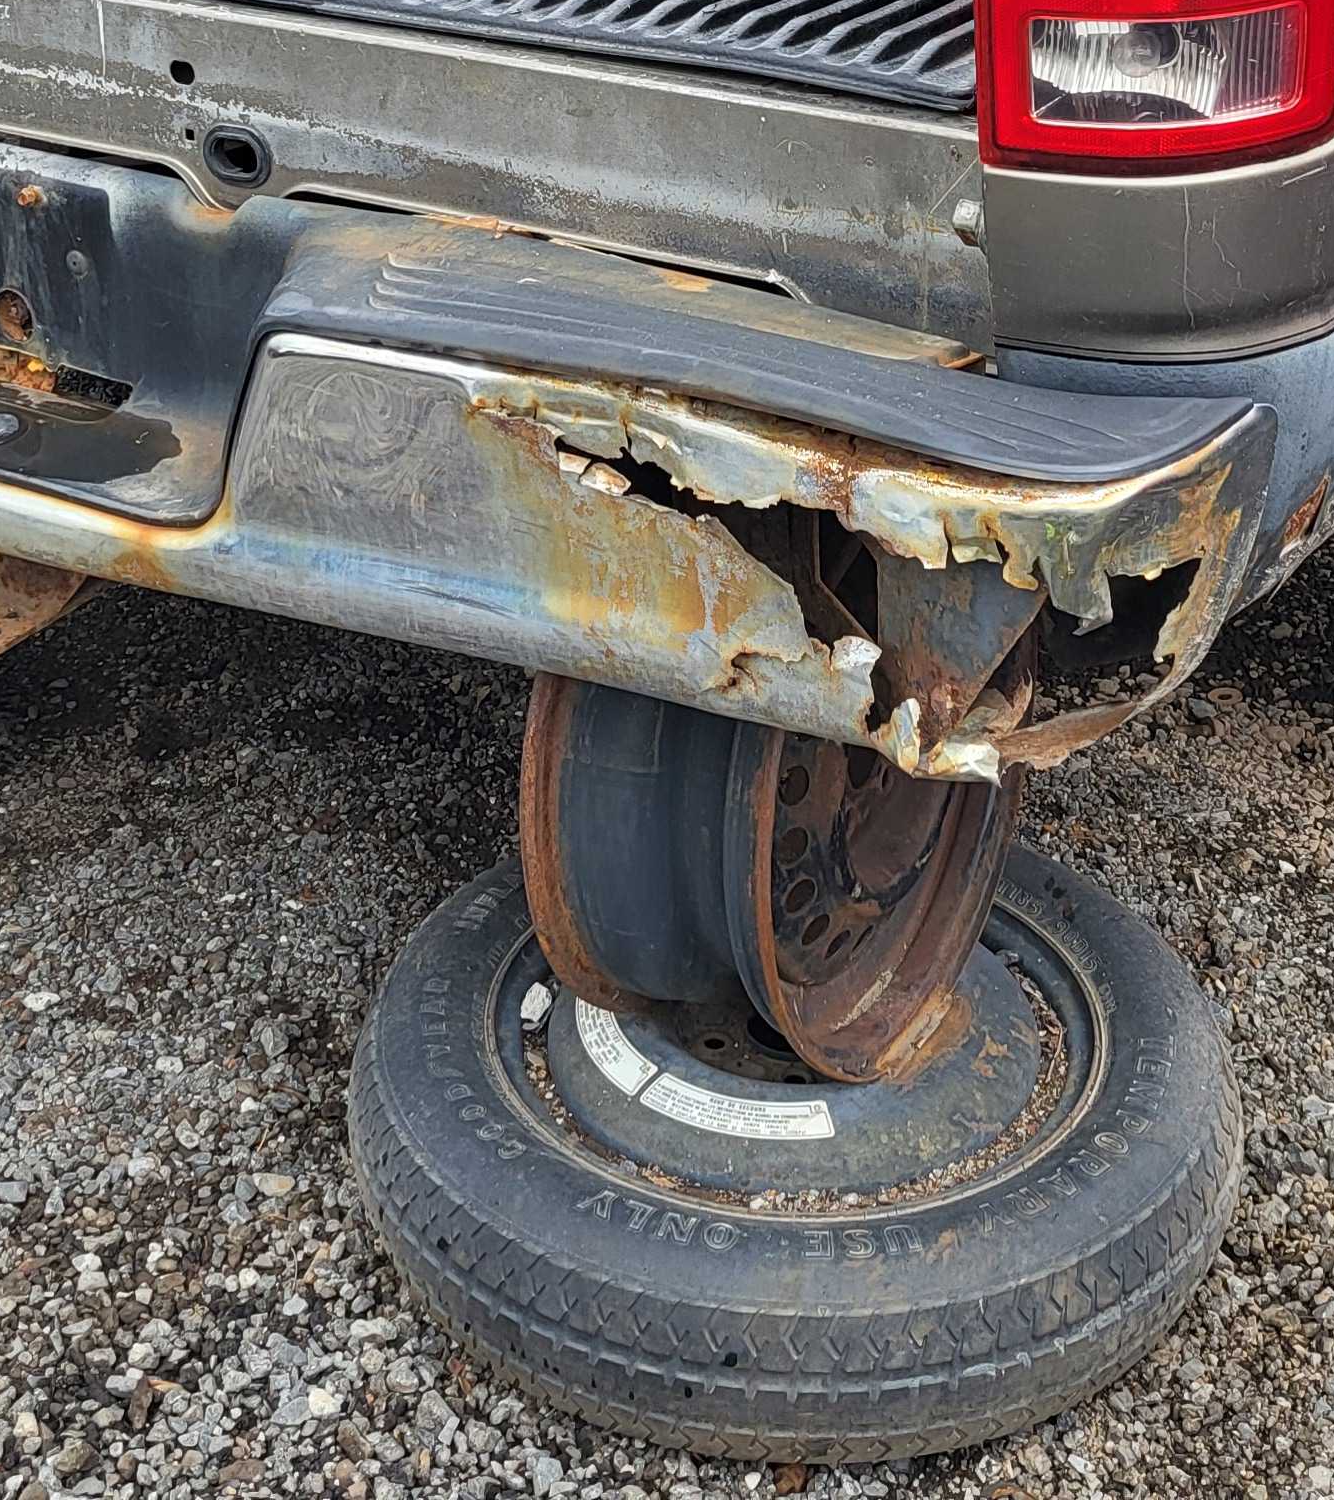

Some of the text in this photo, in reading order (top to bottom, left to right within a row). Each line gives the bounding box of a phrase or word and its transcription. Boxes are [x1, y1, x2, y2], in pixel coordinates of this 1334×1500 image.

[576, 1034, 1177, 1260] TEMPORARY USE ONLY
